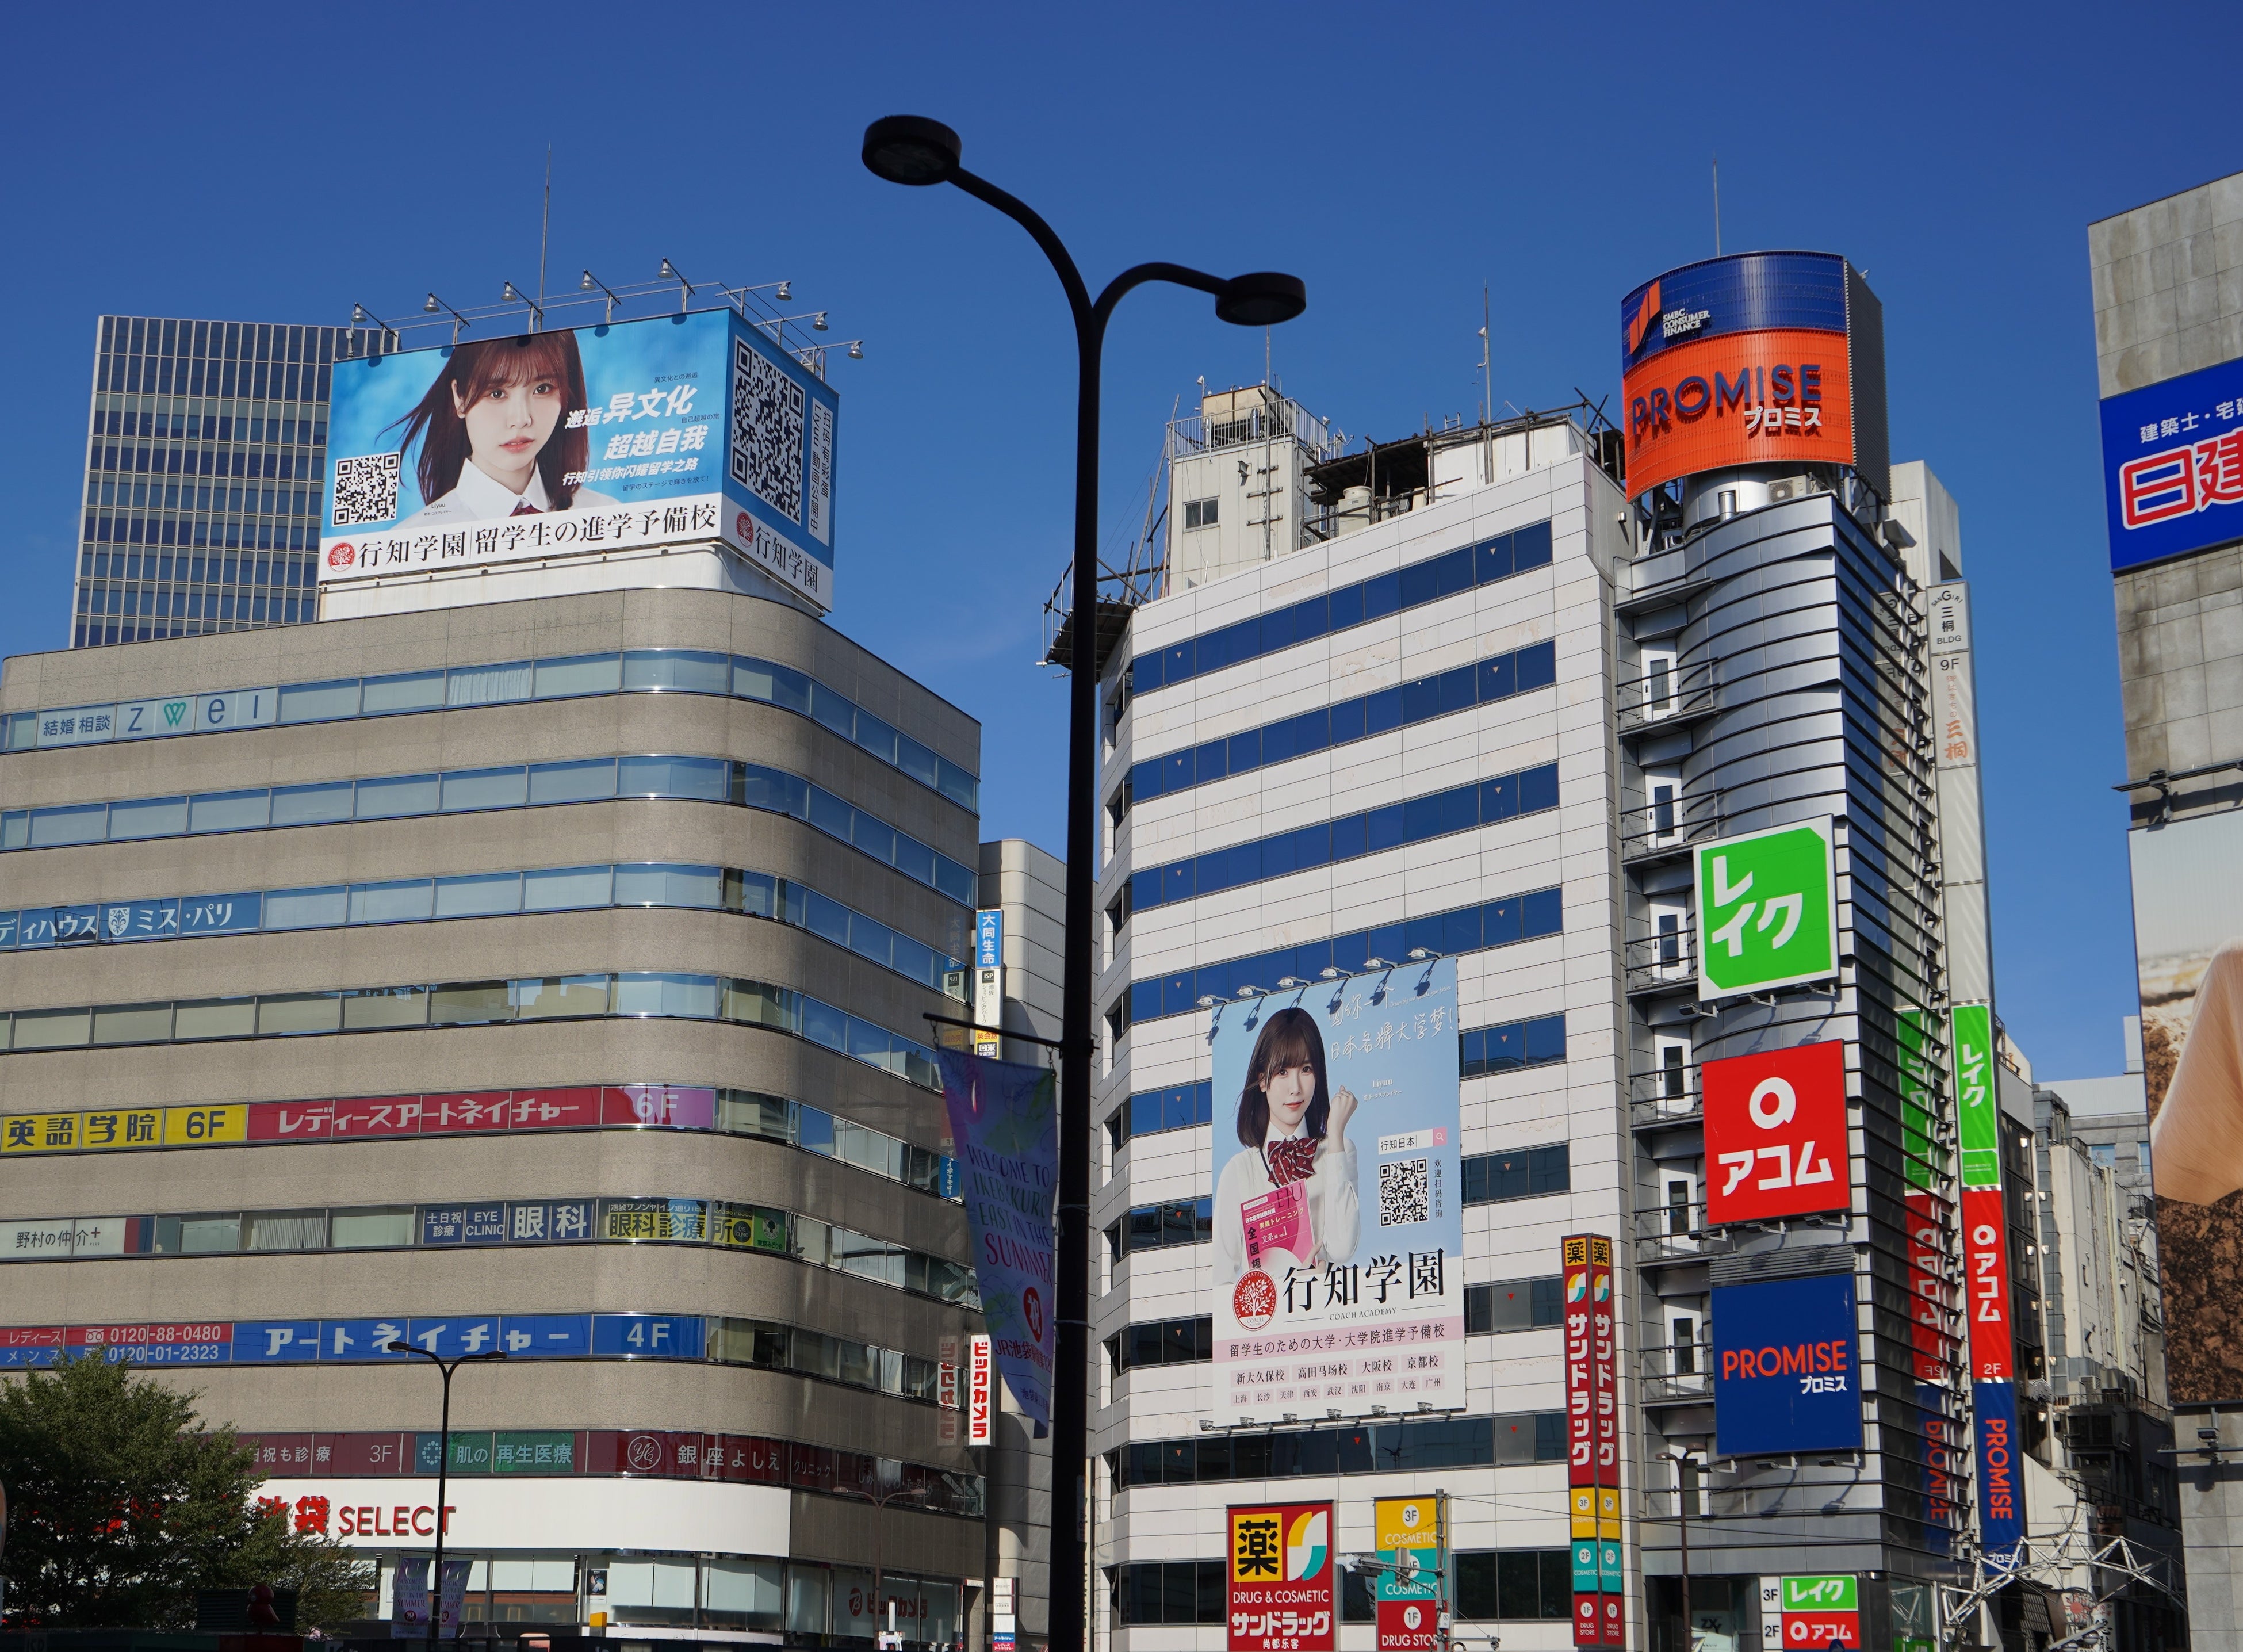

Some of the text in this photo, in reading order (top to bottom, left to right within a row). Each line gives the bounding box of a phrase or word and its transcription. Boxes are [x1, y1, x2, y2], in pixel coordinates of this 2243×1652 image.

[1663, 309, 1686, 323] SMBC
[1663, 310, 1710, 330] CONSUMER
[1663, 320, 1701, 338] FINANCE
[1632, 364, 1822, 435] PROMISE
[682, 413, 719, 423] 自己超越の旅
[1744, 406, 1822, 430] プロミス
[604, 425, 709, 460] 超越自我
[562, 458, 699, 486] 行知引领你闪耀留学之路
[810, 451, 820, 534] 動画公開中
[359, 531, 466, 568] 行知学園
[476, 503, 715, 554] 留学生の進学予備校
[756, 526, 818, 594] 行知学園
[1931, 590, 1963, 607] SANGIRI
[1941, 605, 1954, 632] 三桐
[1937, 635, 1962, 645] BLDG
[1940, 658, 1959, 671] 9F
[43, 714, 111, 736] 結婚相談
[1944, 720, 1968, 760] 三桐
[138, 902, 233, 932] ミス・パリ
[1712, 855, 1803, 957] レイク
[982, 914, 996, 965] 大同生命
[989, 984, 995, 996] 池袋
[977, 1031, 997, 1039] 英会話
[1372, 1079, 1392, 1089] Liyuu
[1962, 1044, 1985, 1107] レイク
[279, 1093, 679, 1133] レディースアートネイチャー 6F
[7, 1111, 226, 1148] 英語学院 6F
[1381, 1136, 1414, 1151] 行知日本
[966, 1144, 1050, 1188] WELCOME TO
[1718, 1141, 1834, 1196] アコム
[1276, 1183, 1302, 1209] EJU
[1434, 1159, 1442, 1218] 欢迎扫码咨询
[427, 1212, 462, 1224] 土日祝
[474, 1211, 498, 1223] EYE
[514, 1205, 587, 1240] 眼科
[610, 1213, 732, 1243] 眼科診療所
[979, 1202, 1052, 1248] EAST IN THE
[433, 1225, 454, 1237] 診療
[466, 1223, 504, 1236] CLINIC
[985, 1233, 1053, 1288] SUMMER
[1567, 1242, 1584, 1264] 薬
[1593, 1242, 1608, 1264] 薬
[1283, 1248, 1444, 1314] 行知学園
[1974, 1252, 2001, 1322] アコム
[1027, 1294, 1041, 1334] 祝
[1329, 1307, 1397, 1321] COACH ACADEMY
[10, 1325, 221, 1344] レディース 0120-88-0480
[266, 1322, 670, 1356] アートネイチャー 4F
[1230, 1323, 1445, 1358] 留学生のための大学・大学院進学予備校
[109, 1345, 219, 1362] 0120-01-2323
[1723, 1340, 1847, 1380] PROMISE
[1236, 1355, 1438, 1385] 新大久保校 高田马场校 大阪校 京都校
[1984, 1363, 2001, 1375] 2F
[973, 1342, 987, 1438] ビックカメラ
[1234, 1377, 1441, 1404] 上海 长沙 天津 西安 武汉 沈阳 南京 大连 广州
[1568, 1313, 1591, 1466] サンドラッグ
[1595, 1313, 1615, 1466] サンドラッグ
[1800, 1376, 1847, 1395] プロミス
[369, 1445, 392, 1463] 3F
[456, 1443, 572, 1464] 肌の再生医療
[678, 1445, 832, 1478] 銀座よしえ クリニック
[1986, 1420, 2012, 1519] PROMISE
[339, 1506, 456, 1535] SELECT
[1405, 1510, 1417, 1521] 3F
[1238, 1520, 1279, 1576] 薬
[1385, 1531, 1437, 1545] COSMETIC
[1581, 1552, 1589, 1560] 2F
[1607, 1553, 1614, 1561] 2F
[397, 1599, 426, 1607] SUMMER
[1234, 1589, 1329, 1604] DRUG & COSMETIC
[1763, 1581, 1844, 1603] 3F レイク
[1408, 1612, 1418, 1623] 1F
[1583, 1606, 1591, 1614] 1F
[1609, 1606, 1616, 1615] 1F
[1231, 1611, 1330, 1636] サンドラッグ
[1764, 1624, 1852, 1640] 2F アコム
[1263, 1638, 1299, 1649] 尚都乐客
[1381, 1635, 1410, 1646] DRUG
